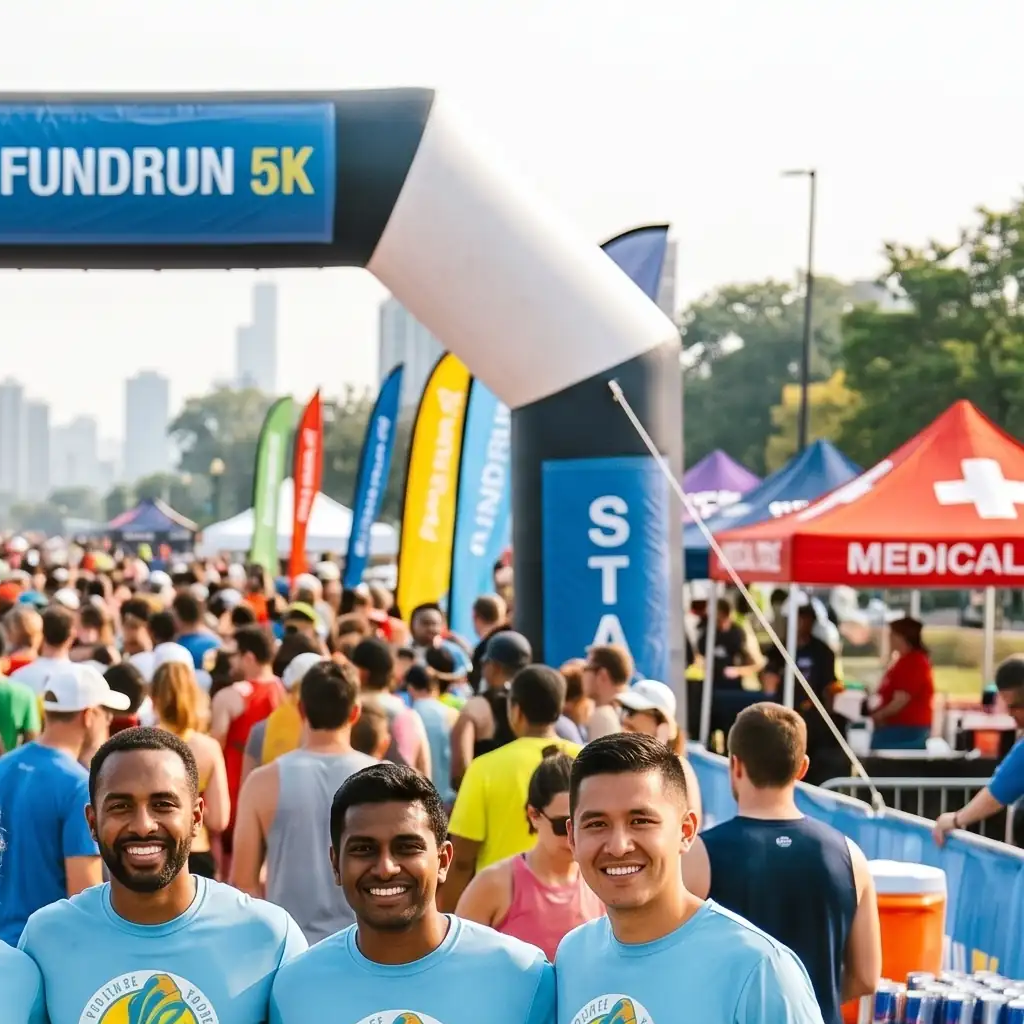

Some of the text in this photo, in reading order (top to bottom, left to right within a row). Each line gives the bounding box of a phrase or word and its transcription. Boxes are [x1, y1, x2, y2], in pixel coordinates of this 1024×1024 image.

[0, 147, 235, 197] FUNDRUN
[250, 146, 315, 196] 5K
[847, 542, 1024, 576] MEDICAL
